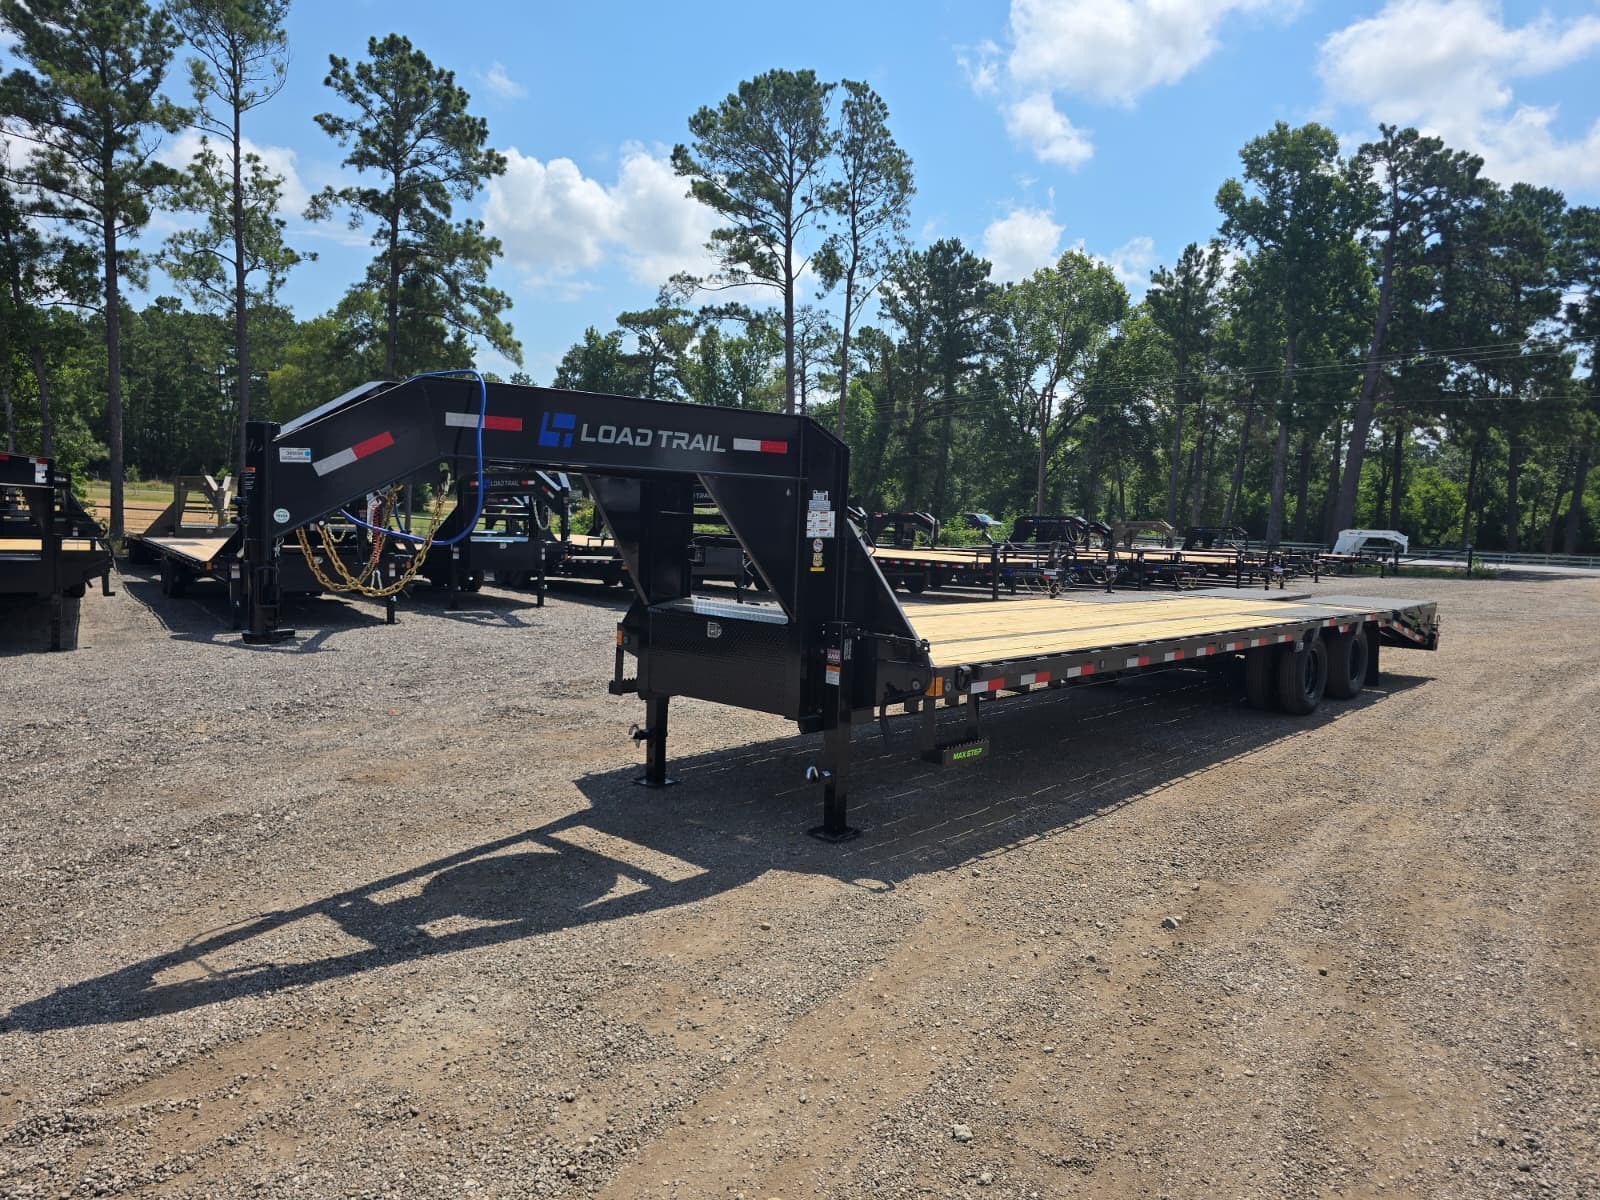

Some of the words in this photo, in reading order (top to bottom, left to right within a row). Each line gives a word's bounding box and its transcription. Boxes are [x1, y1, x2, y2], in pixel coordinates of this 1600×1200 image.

[580, 423, 653, 446] LOAD
[657, 430, 727, 453] TRAIL
[952, 751, 966, 761] MAX
[966, 747, 983, 758] STEP
